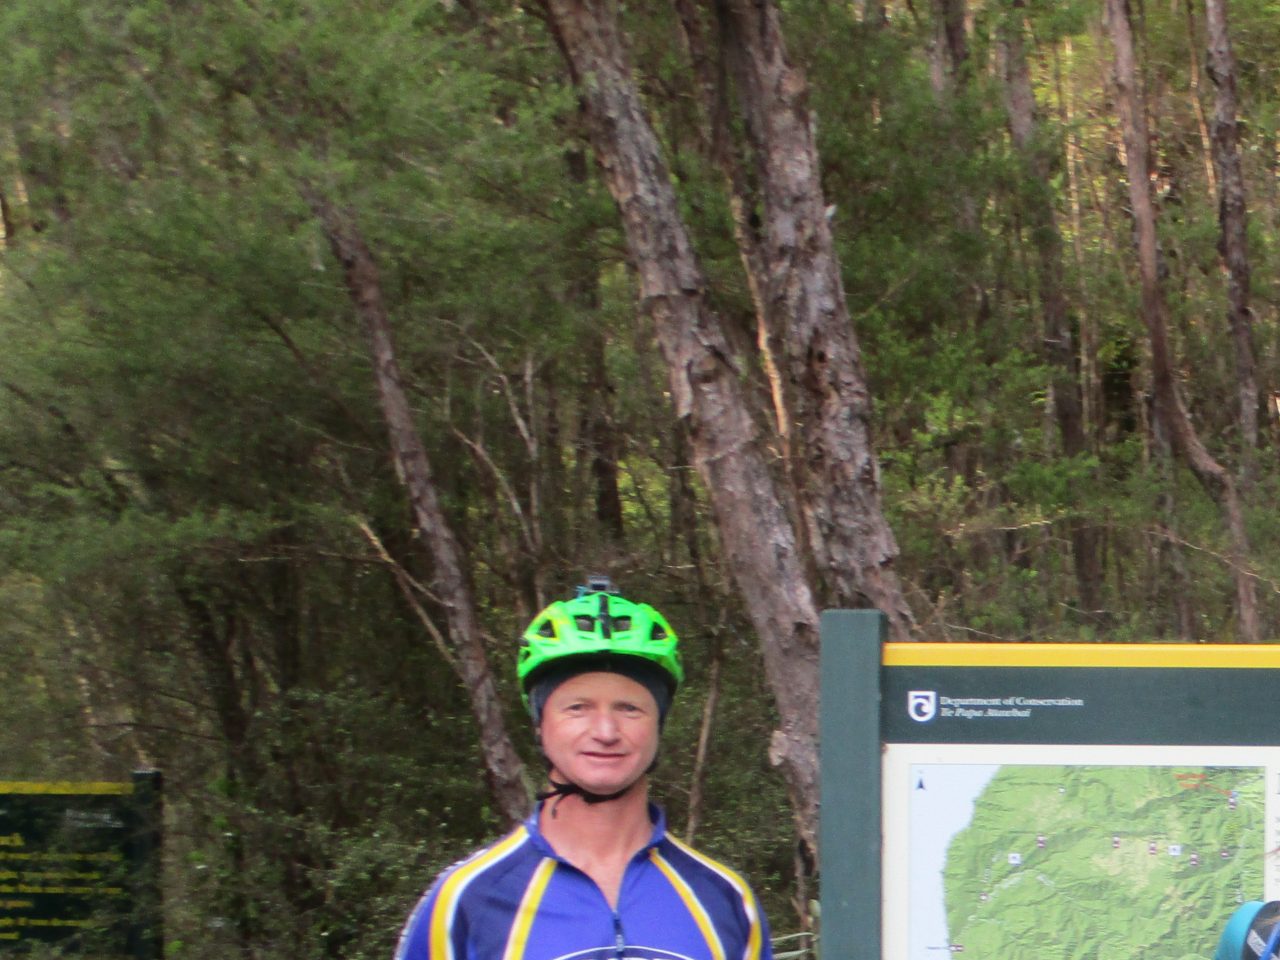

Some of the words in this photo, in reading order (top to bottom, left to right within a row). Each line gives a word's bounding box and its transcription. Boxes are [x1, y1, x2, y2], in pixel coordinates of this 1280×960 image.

[940, 696, 1001, 707] Department
[1002, 696, 1016, 706] of
[1016, 696, 1084, 706] Conservation
